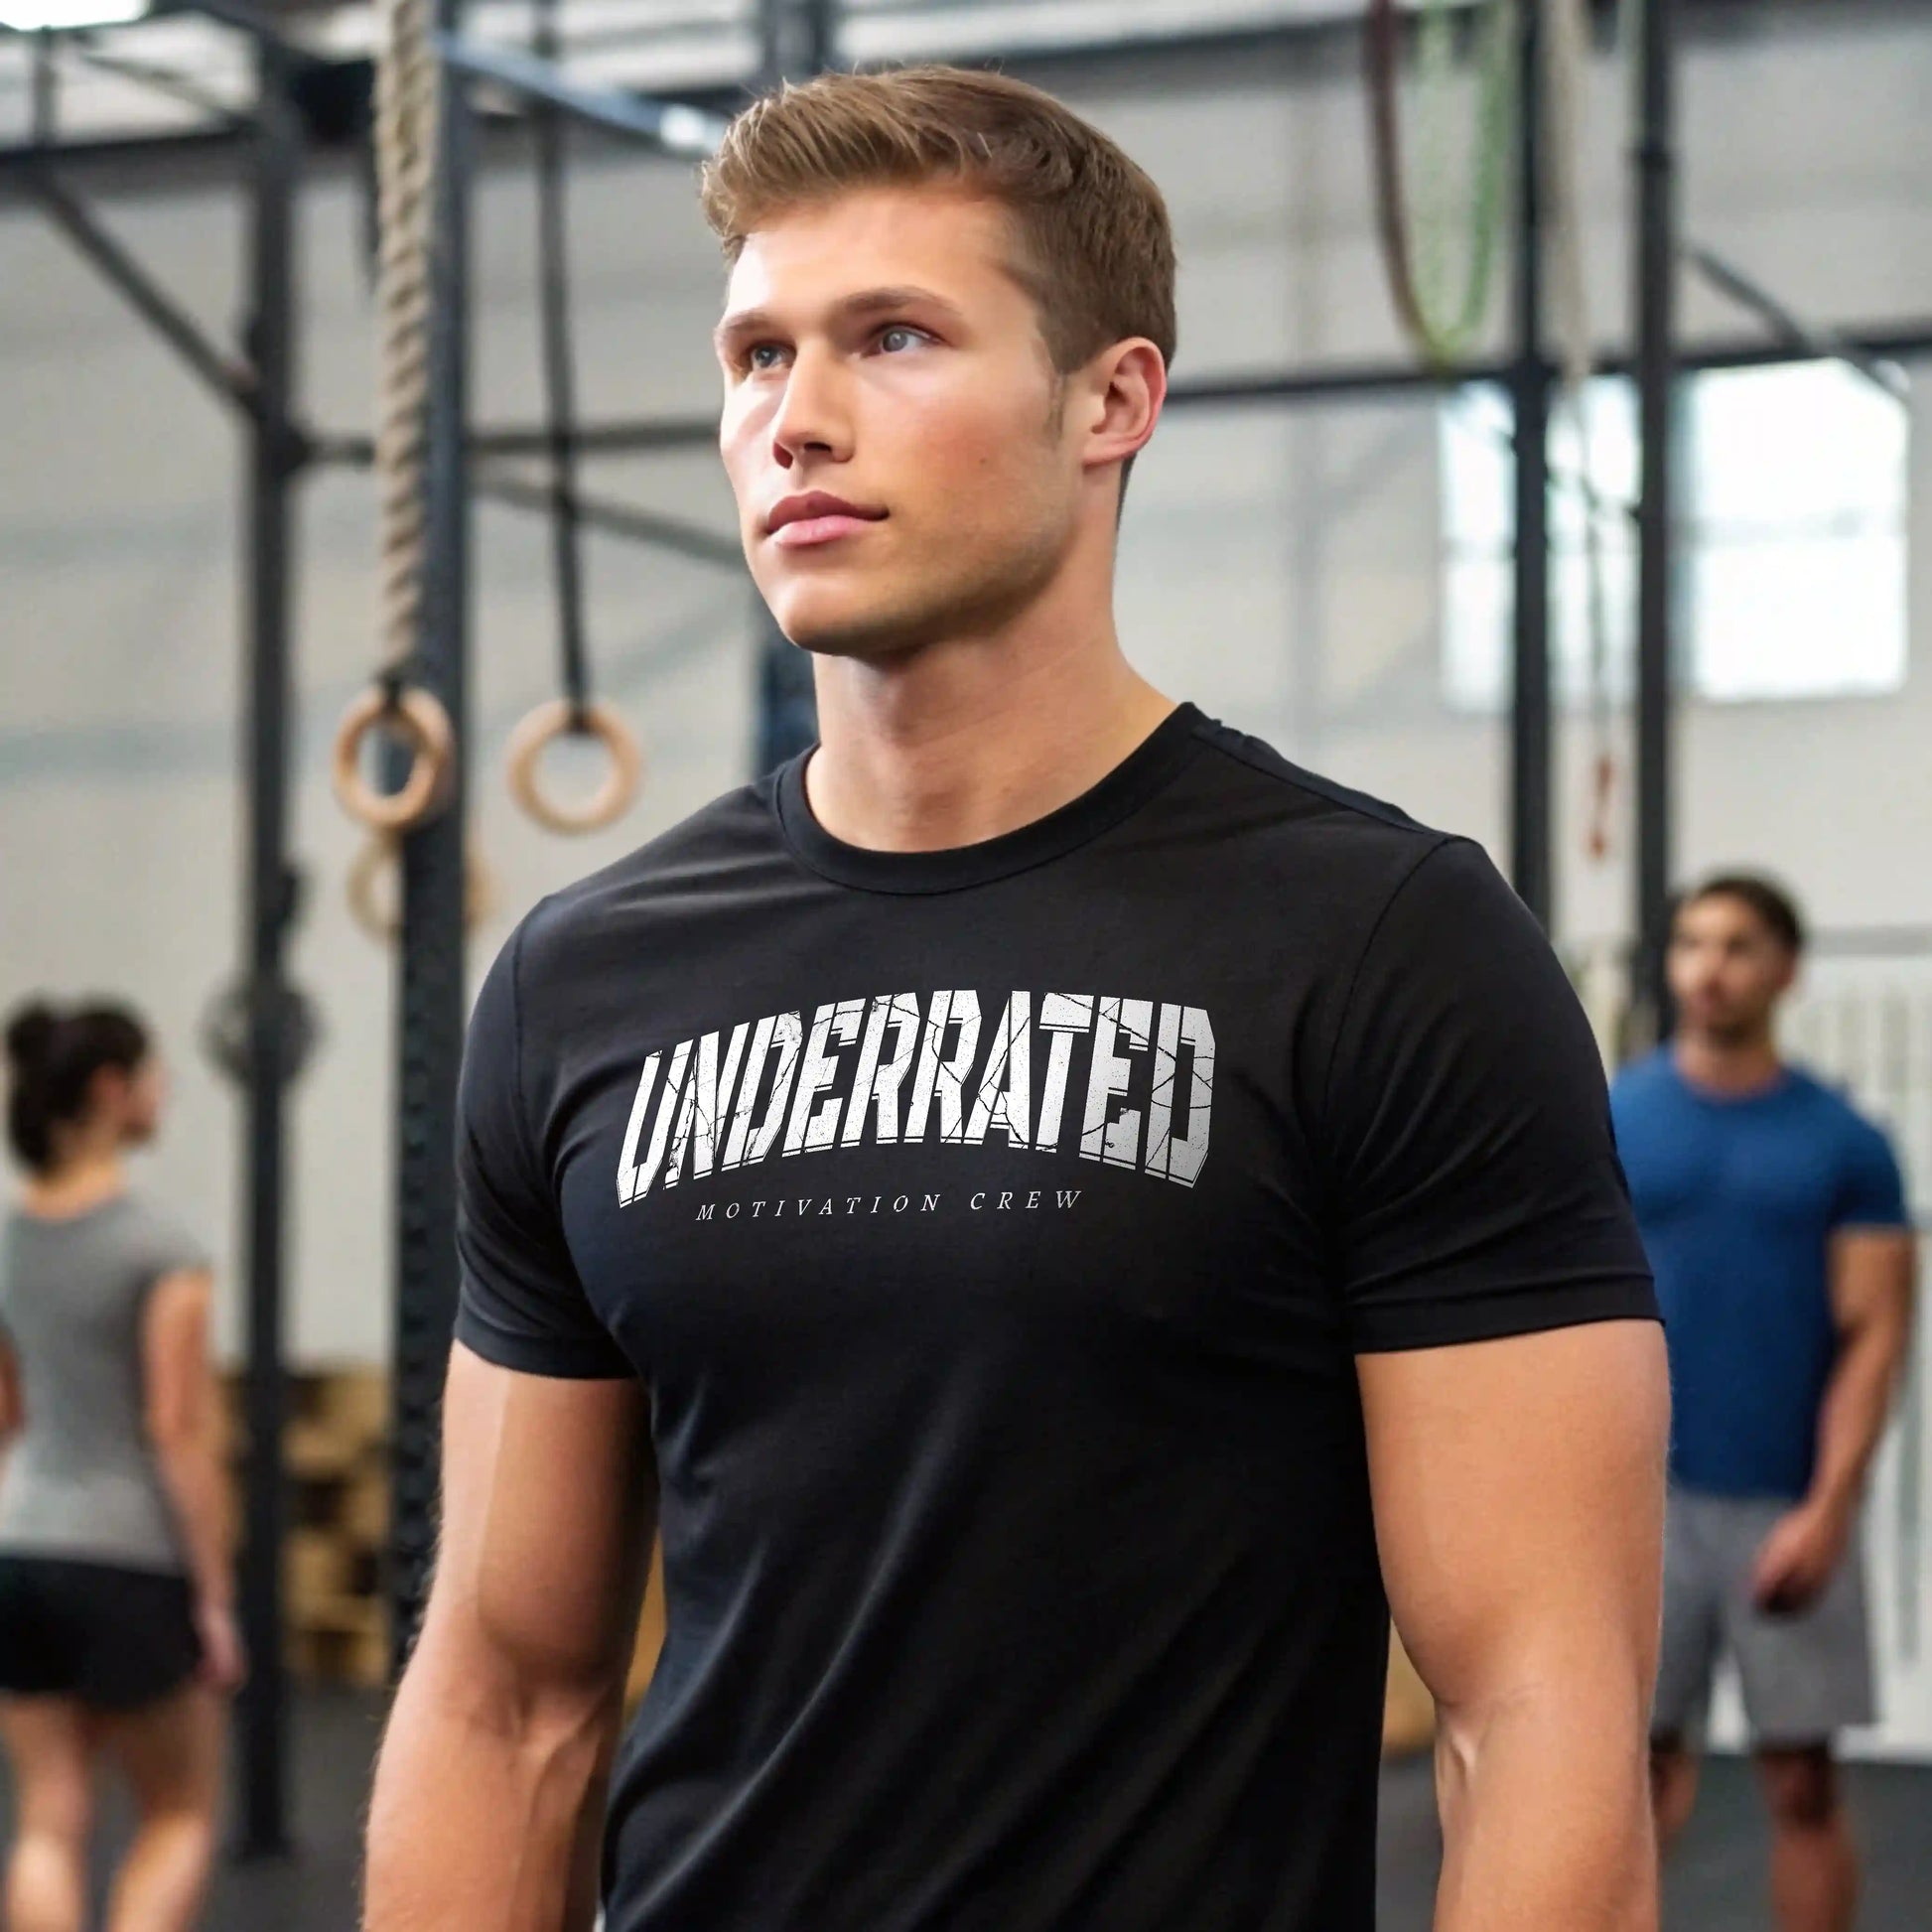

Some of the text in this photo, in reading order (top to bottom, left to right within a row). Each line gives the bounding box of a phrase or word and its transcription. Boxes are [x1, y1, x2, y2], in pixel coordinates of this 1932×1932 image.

[617, 989, 1216, 1208] UNDERRATED
[695, 1190, 1083, 1221] MOTIVATION CREW
